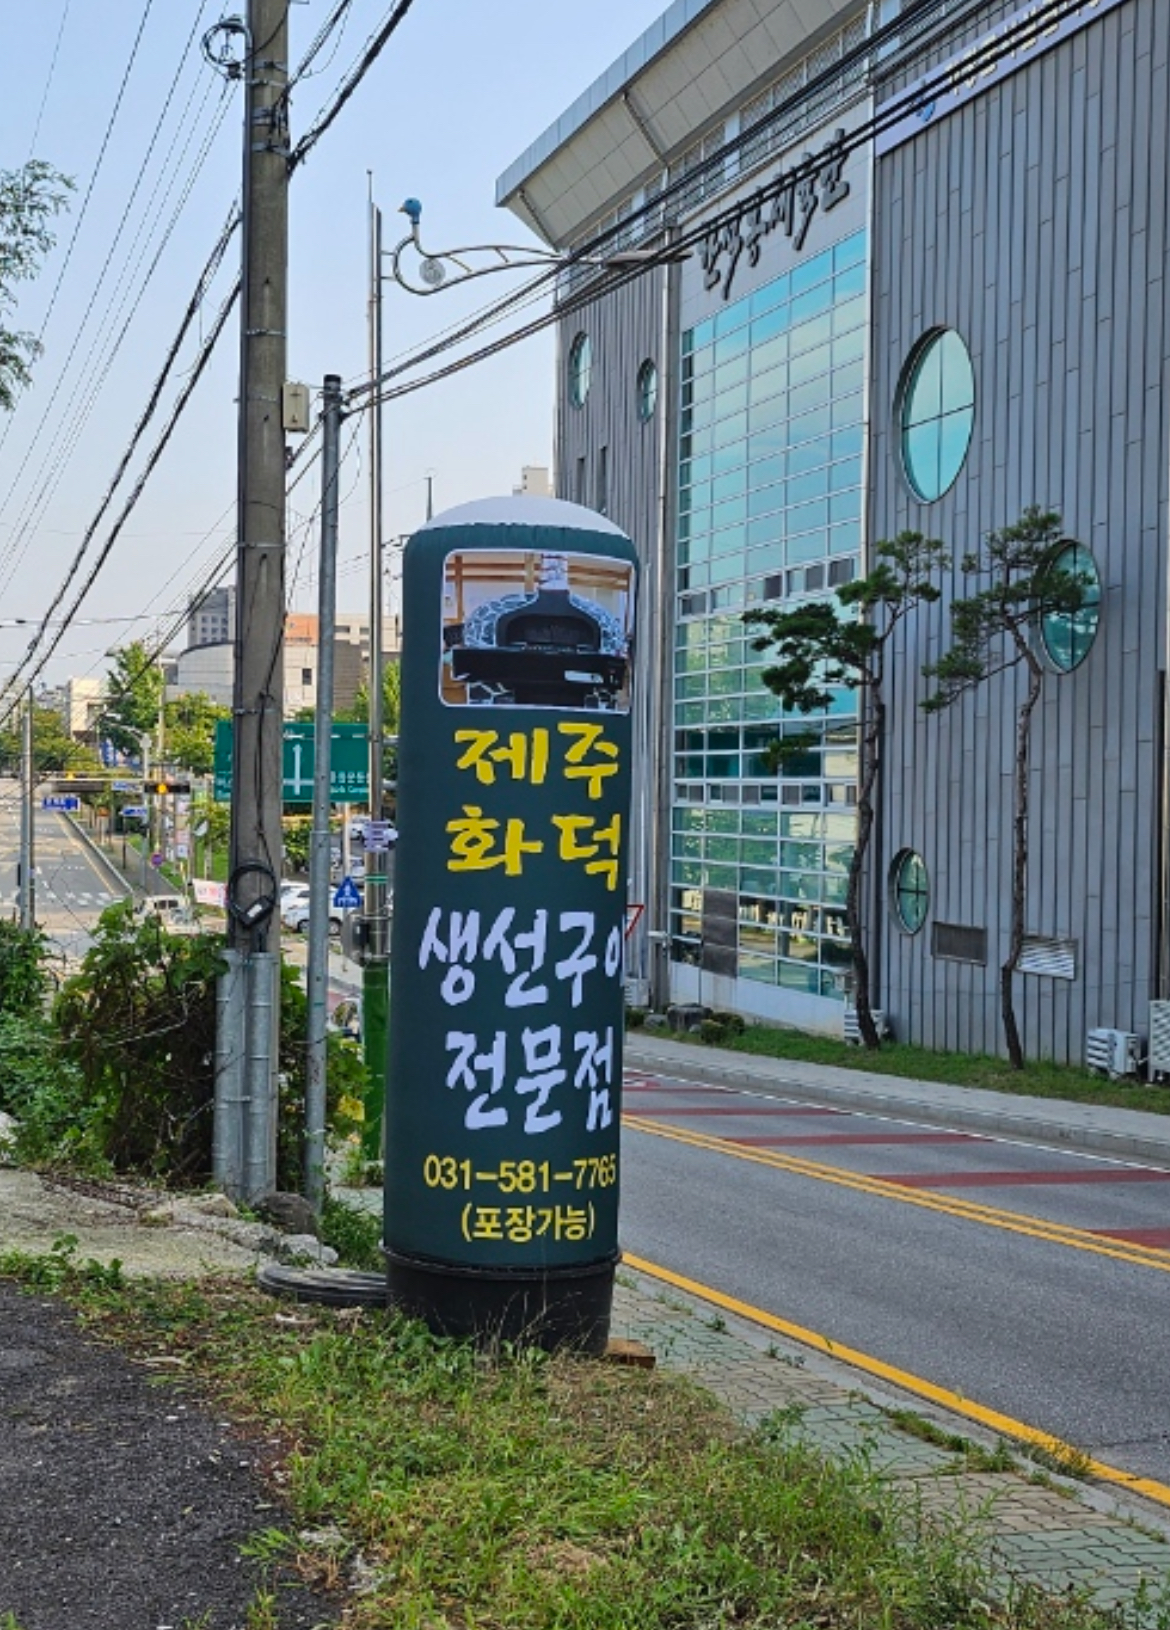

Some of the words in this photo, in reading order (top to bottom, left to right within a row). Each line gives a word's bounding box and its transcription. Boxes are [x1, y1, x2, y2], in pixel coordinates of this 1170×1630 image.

[454, 722, 619, 799] 제주
[445, 805, 621, 891] 화덕
[445, 1023, 614, 1135] 전문점
[423, 1153, 616, 1193] 031-581-7765
[461, 1202, 595, 1243] (포장가능)
